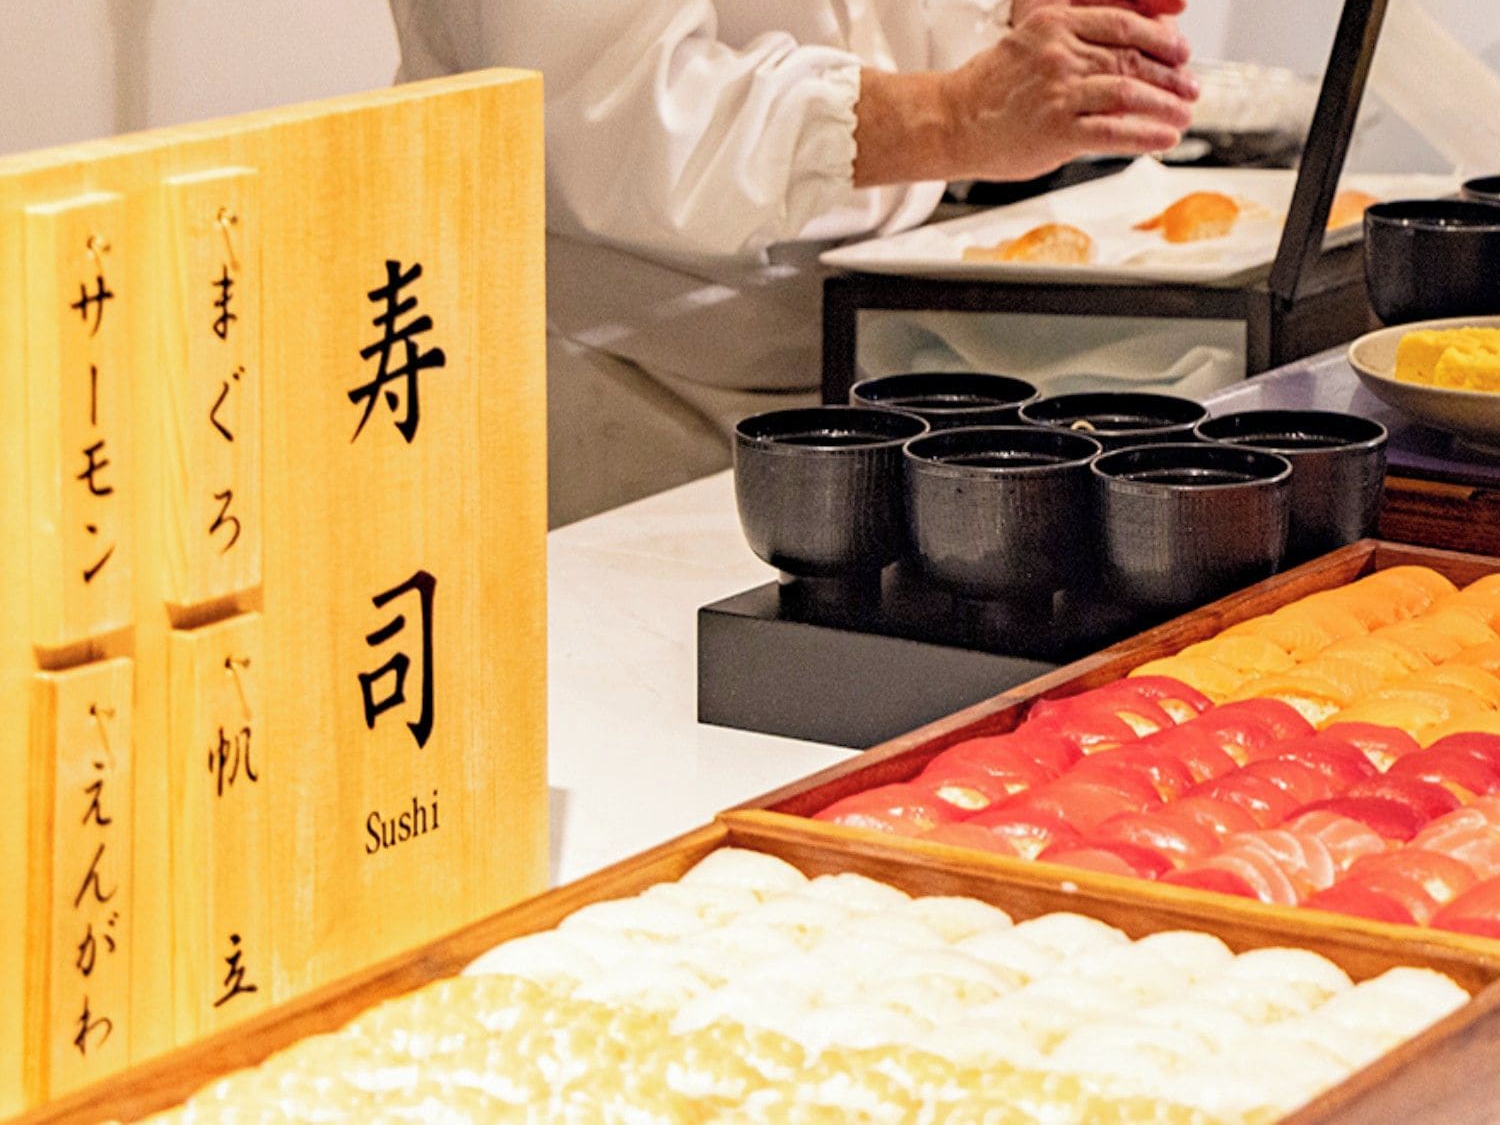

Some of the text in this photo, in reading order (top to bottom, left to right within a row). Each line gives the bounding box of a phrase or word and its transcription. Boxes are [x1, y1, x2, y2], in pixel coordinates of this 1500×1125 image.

[71, 273, 115, 585] サーモン
[209, 265, 246, 553] まぐろ
[347, 259, 446, 749] 寿司
[74, 761, 118, 1057] えんがわ
[208, 724, 258, 1008] 帆立
[365, 789, 440, 855] Sushi
